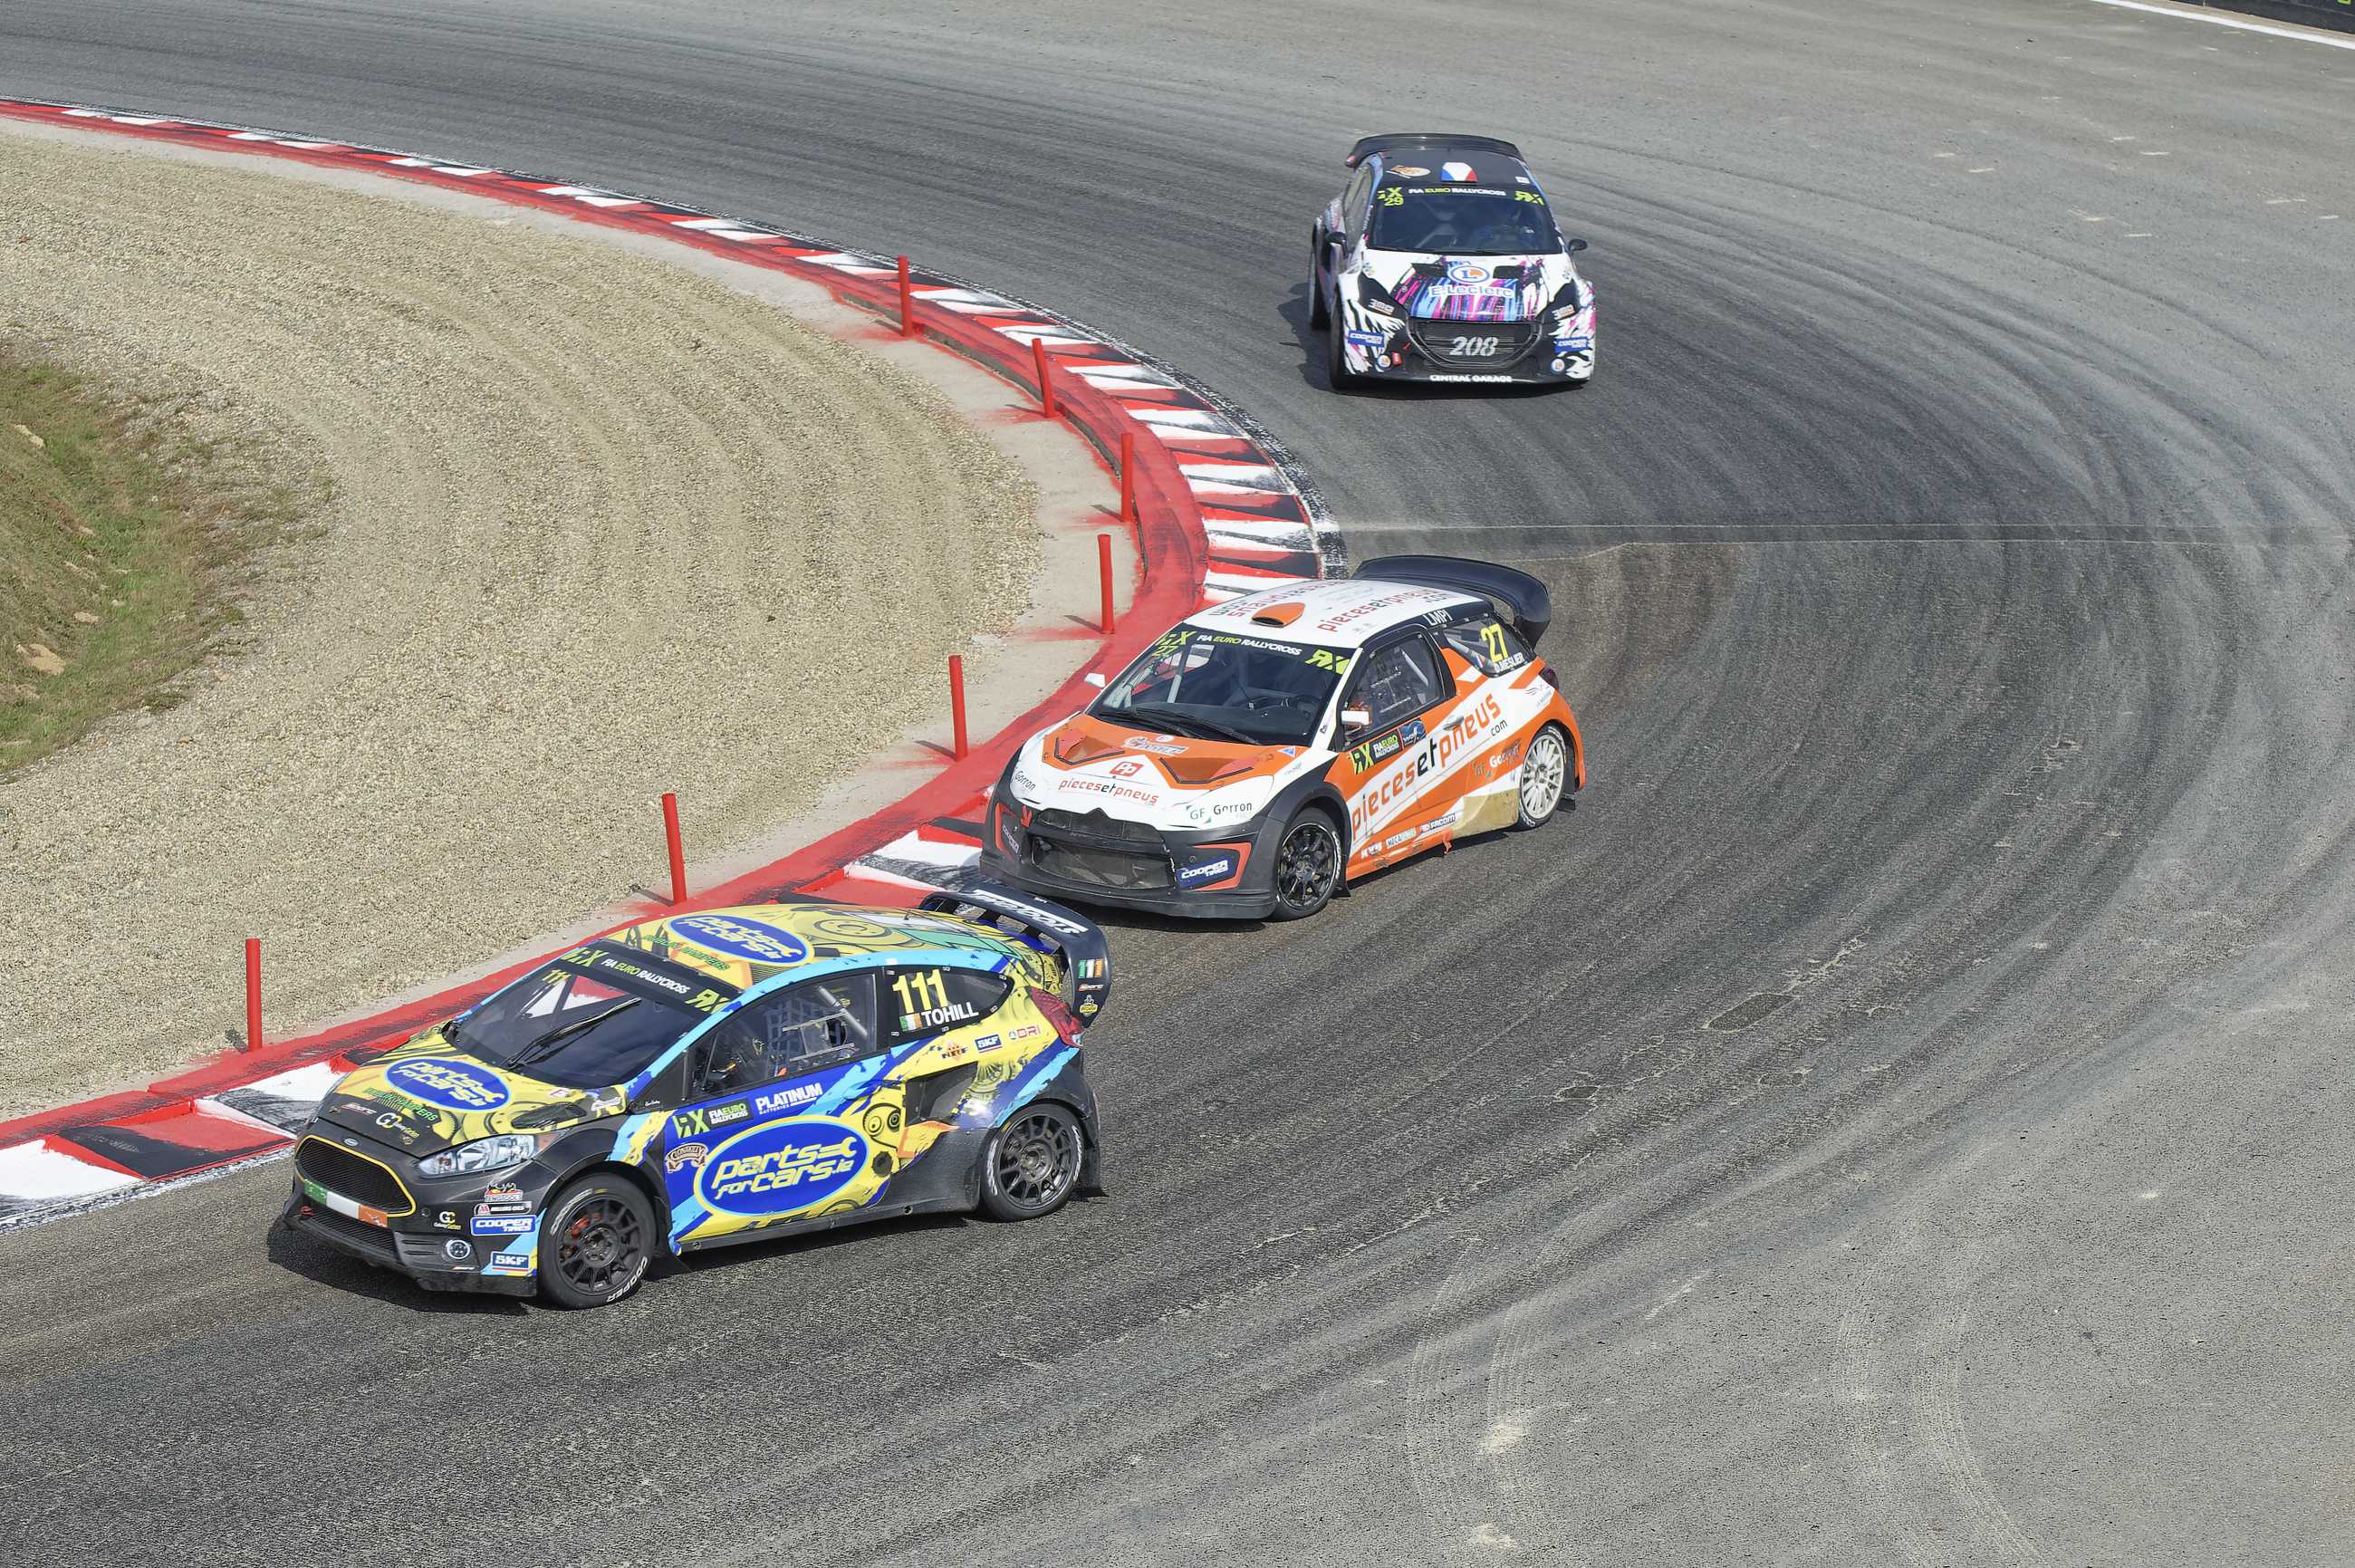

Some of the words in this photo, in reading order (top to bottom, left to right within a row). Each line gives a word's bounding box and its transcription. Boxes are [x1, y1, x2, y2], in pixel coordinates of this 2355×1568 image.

[1384, 196, 1404, 207] 29
[1452, 188, 1507, 197] RALLYCROSS
[1449, 336, 1499, 357] 208
[1429, 374, 1471, 382] CENTRAL
[1472, 374, 1513, 382] GARAGE
[1152, 645, 1178, 657] 27
[1197, 634, 1212, 642] FIA
[1213, 636, 1242, 644] EURO
[1241, 639, 1302, 655] RALLYCROSS
[1481, 623, 1508, 662] 27
[1058, 778, 1159, 803] piecesetpneus
[1181, 860, 1228, 879] COOPER
[601, 958, 617, 968] FIA
[616, 962, 640, 976] EURO
[636, 969, 691, 995] RALLYCROSS
[892, 968, 948, 1014] 111
[921, 1001, 979, 1026] TOHILL
[977, 1035, 999, 1048] SKF
[755, 1082, 823, 1111] PLATINUM
[711, 1110, 748, 1125] RALLYCROSS
[711, 1143, 822, 1189] parts
[475, 1217, 533, 1228] COOPER
[495, 1255, 527, 1265] SKF
[606, 1255, 649, 1303] COOPER
